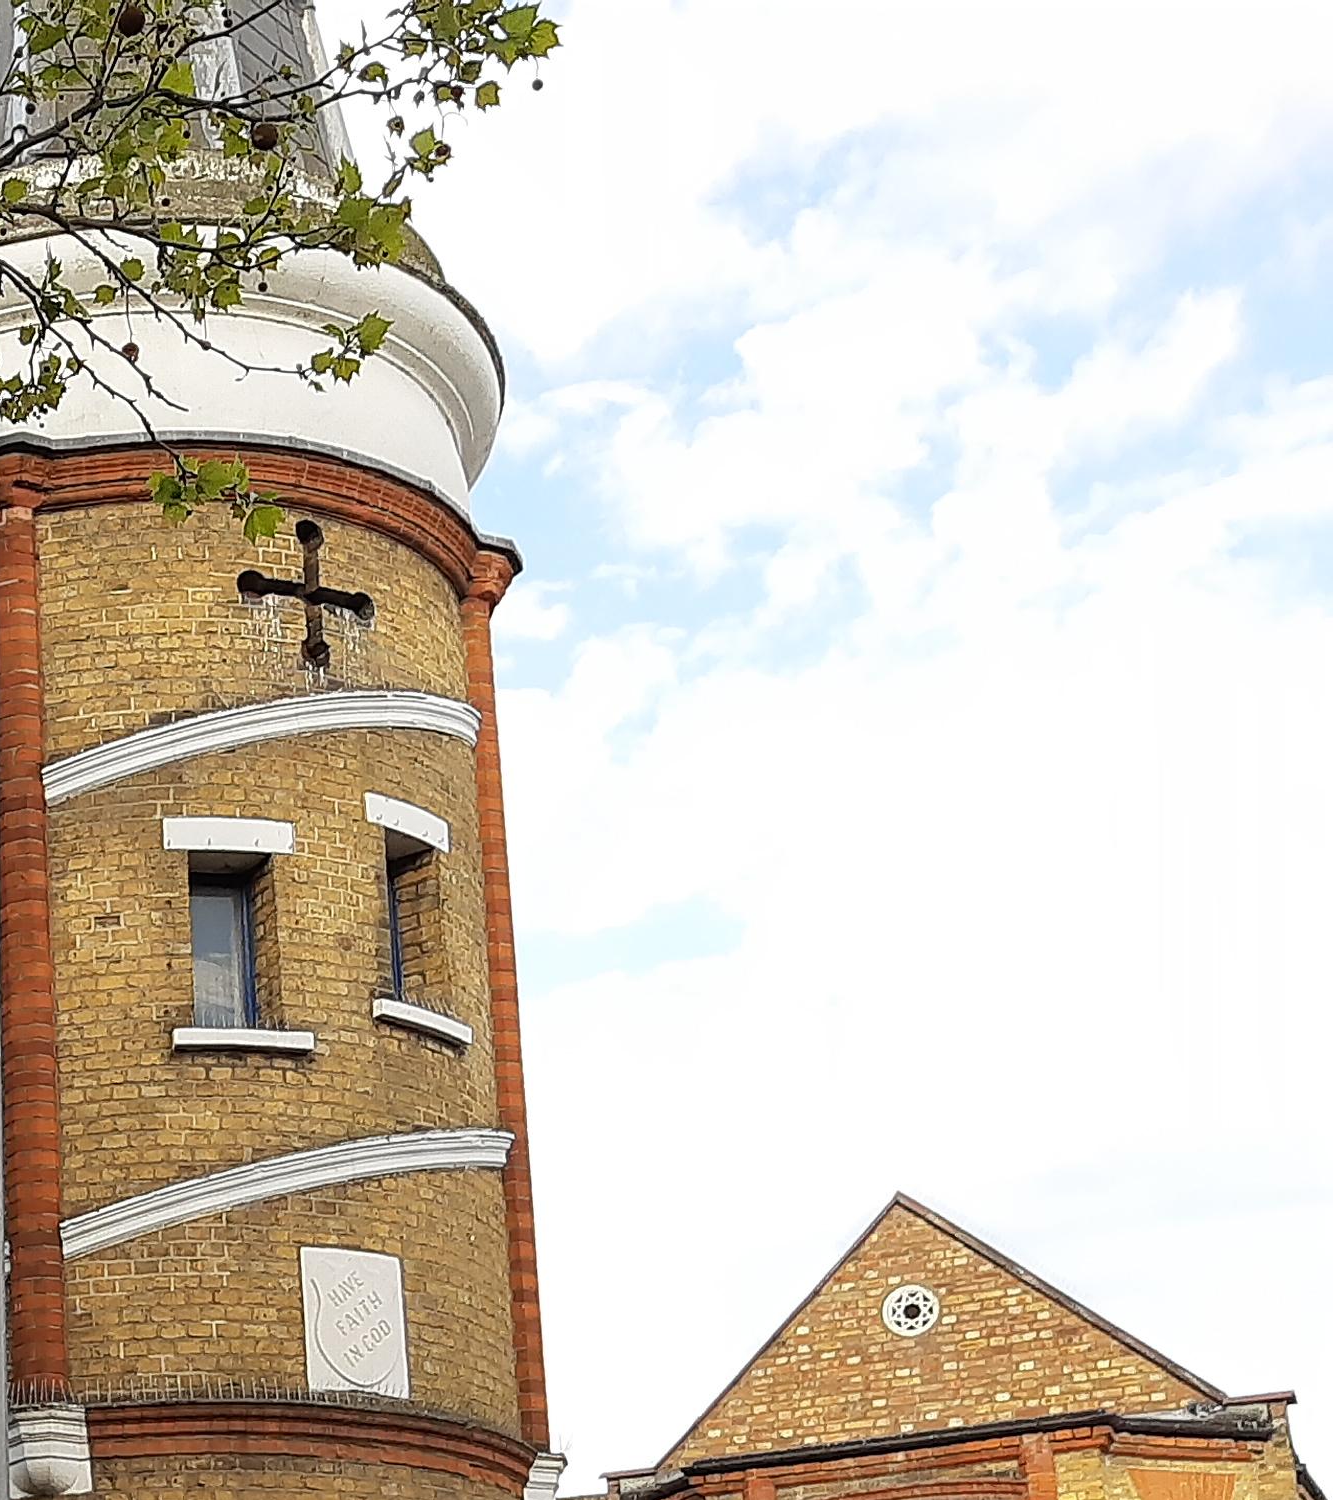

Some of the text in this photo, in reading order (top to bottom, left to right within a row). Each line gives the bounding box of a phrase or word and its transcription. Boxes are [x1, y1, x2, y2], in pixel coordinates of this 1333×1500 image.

[328, 1271, 364, 1308] HAVE
[335, 1290, 383, 1337] FAITH
[343, 1344, 364, 1368] IN
